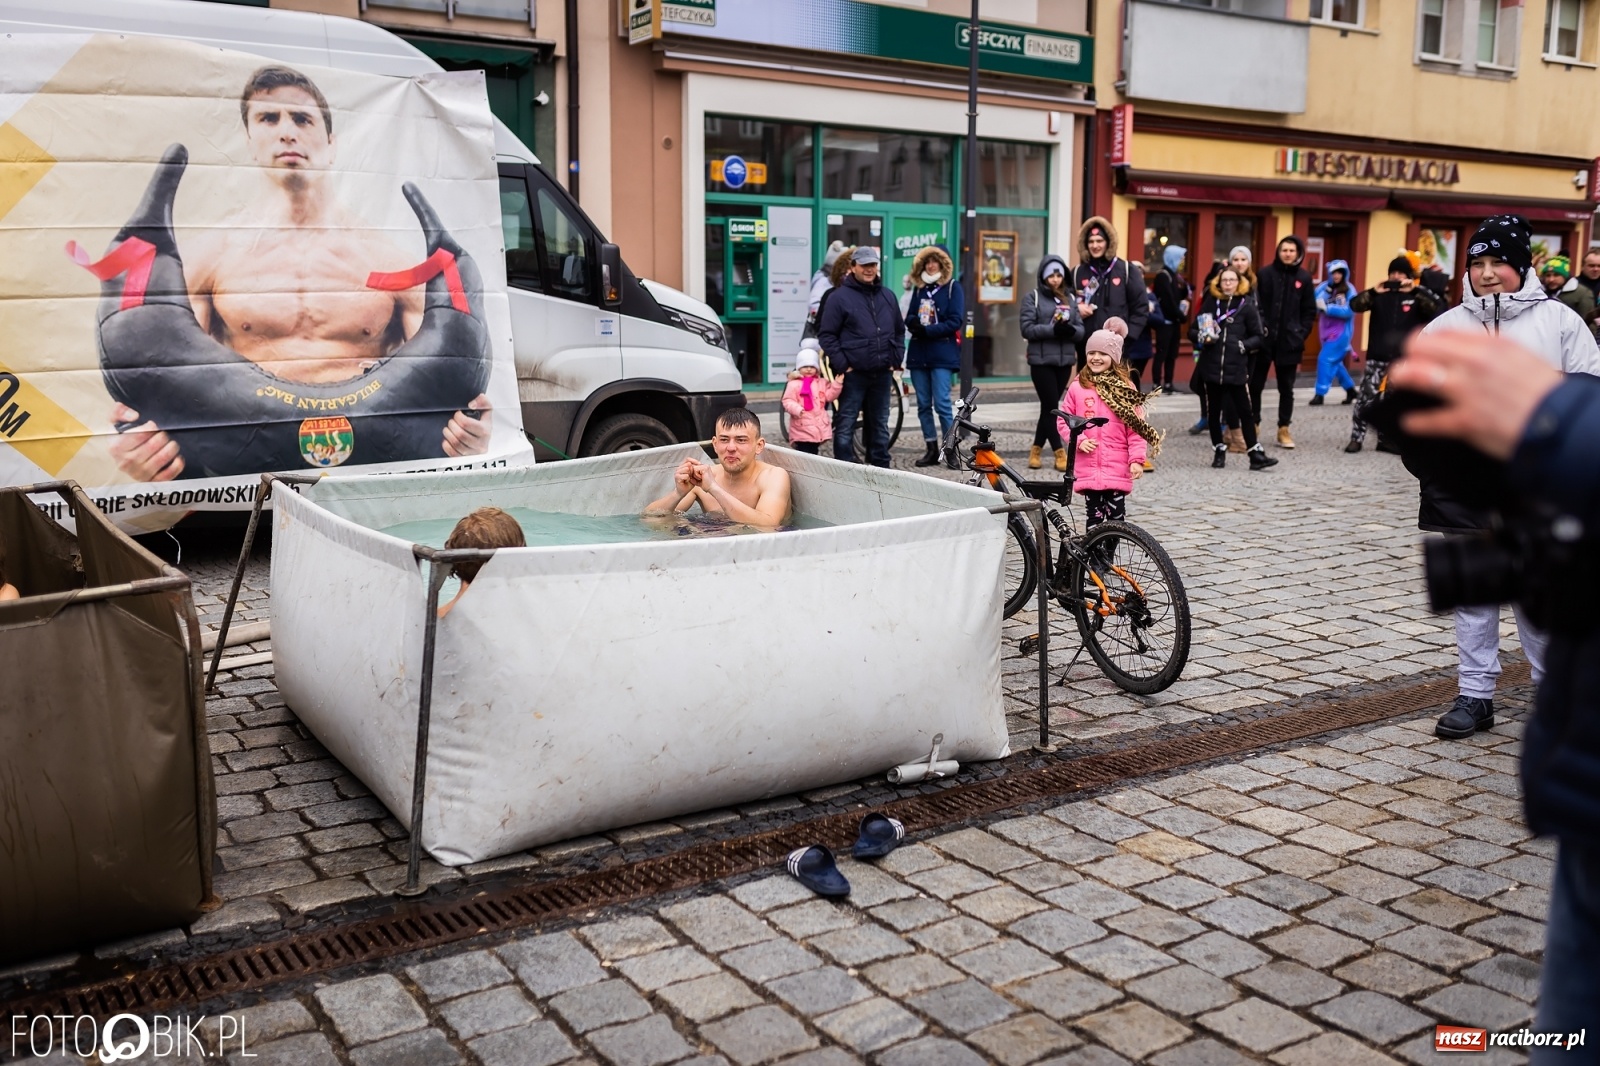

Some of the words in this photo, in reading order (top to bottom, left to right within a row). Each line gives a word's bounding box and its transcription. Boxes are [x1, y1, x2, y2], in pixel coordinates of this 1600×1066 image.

[660, 6, 714, 24] TEFCZYKA
[961, 28, 1022, 51] SEFCZYK
[1026, 38, 1076, 59] FINANSE
[1304, 151, 1460, 183] RESTAURACJA
[895, 233, 938, 250] GRAMY
[297, 380, 383, 411] BULGARIAN
